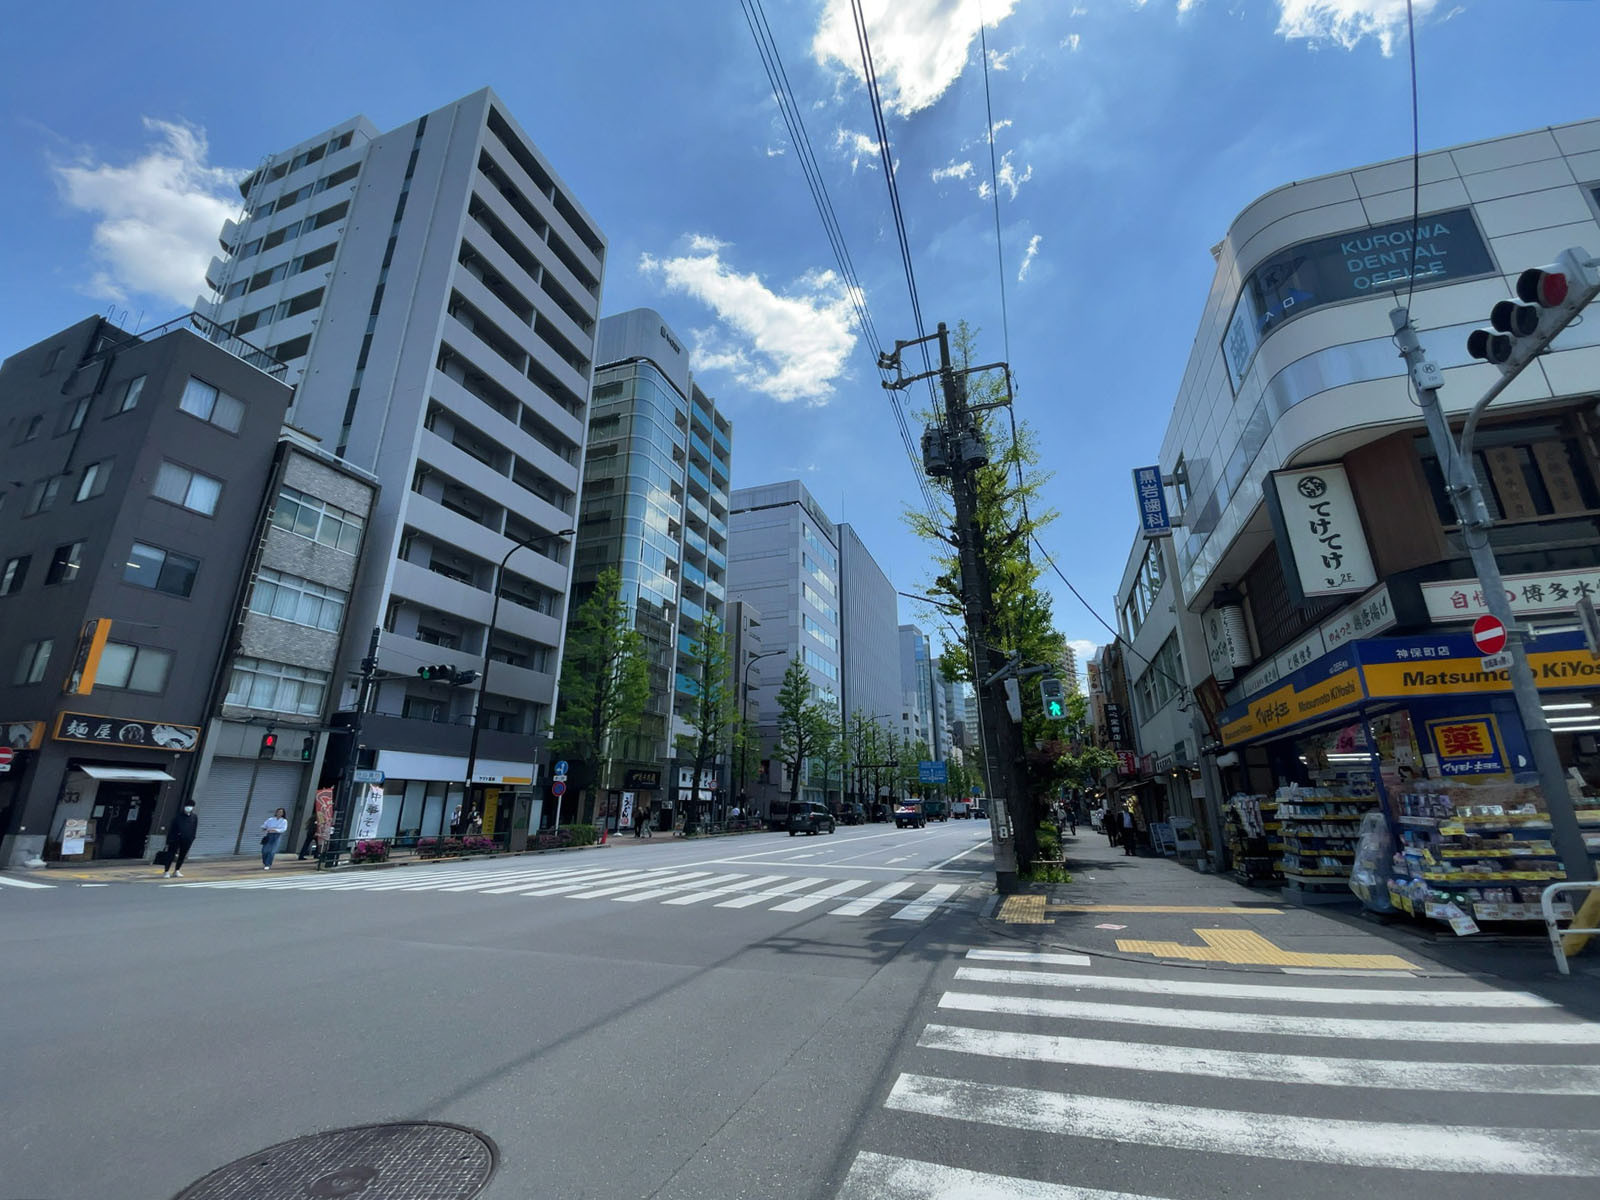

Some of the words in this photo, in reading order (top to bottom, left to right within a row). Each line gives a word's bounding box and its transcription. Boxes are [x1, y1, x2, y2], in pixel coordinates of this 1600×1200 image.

[1341, 223, 1451, 255] KUROIWA
[1347, 243, 1448, 273] DENTAL
[1354, 260, 1447, 289] OFFICE
[1309, 501, 1343, 570] てけてけ
[1396, 646, 1450, 660] 神保町店
[1441, 725, 1485, 755] 薬
